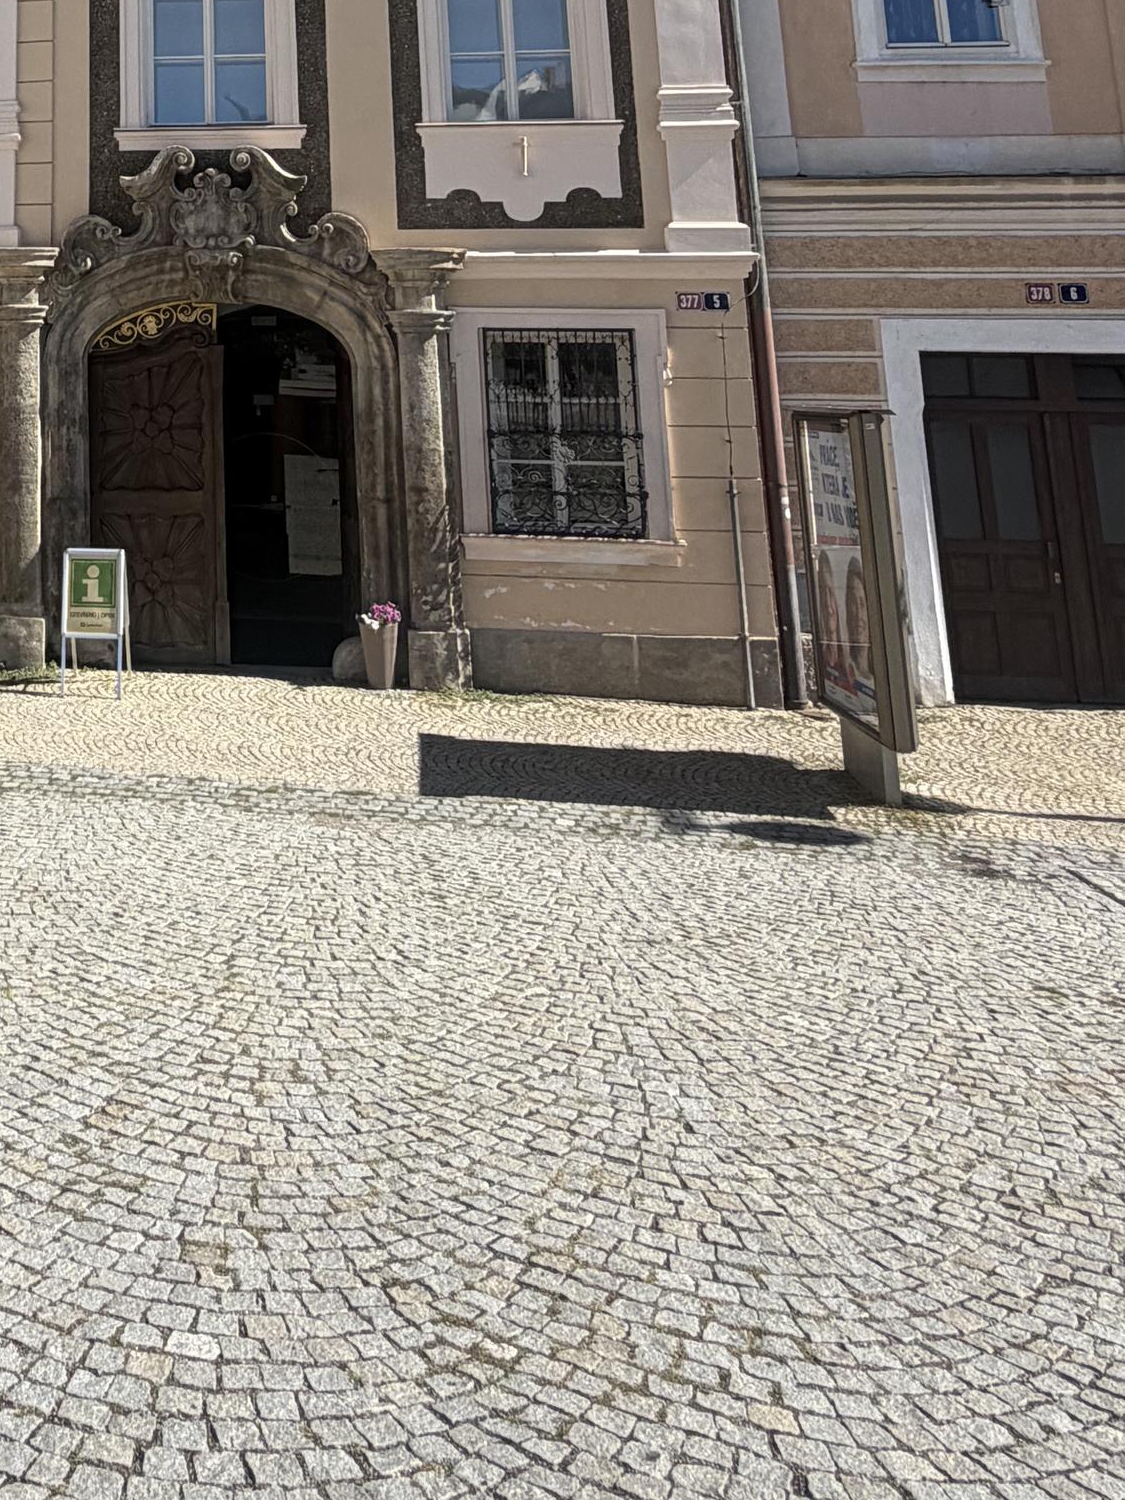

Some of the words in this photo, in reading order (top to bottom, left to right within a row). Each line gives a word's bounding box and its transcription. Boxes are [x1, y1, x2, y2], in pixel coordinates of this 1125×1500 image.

[1030, 287, 1051, 300] 378
[1069, 287, 1078, 300] 6
[680, 295, 699, 308] 377
[713, 295, 721, 308] 5
